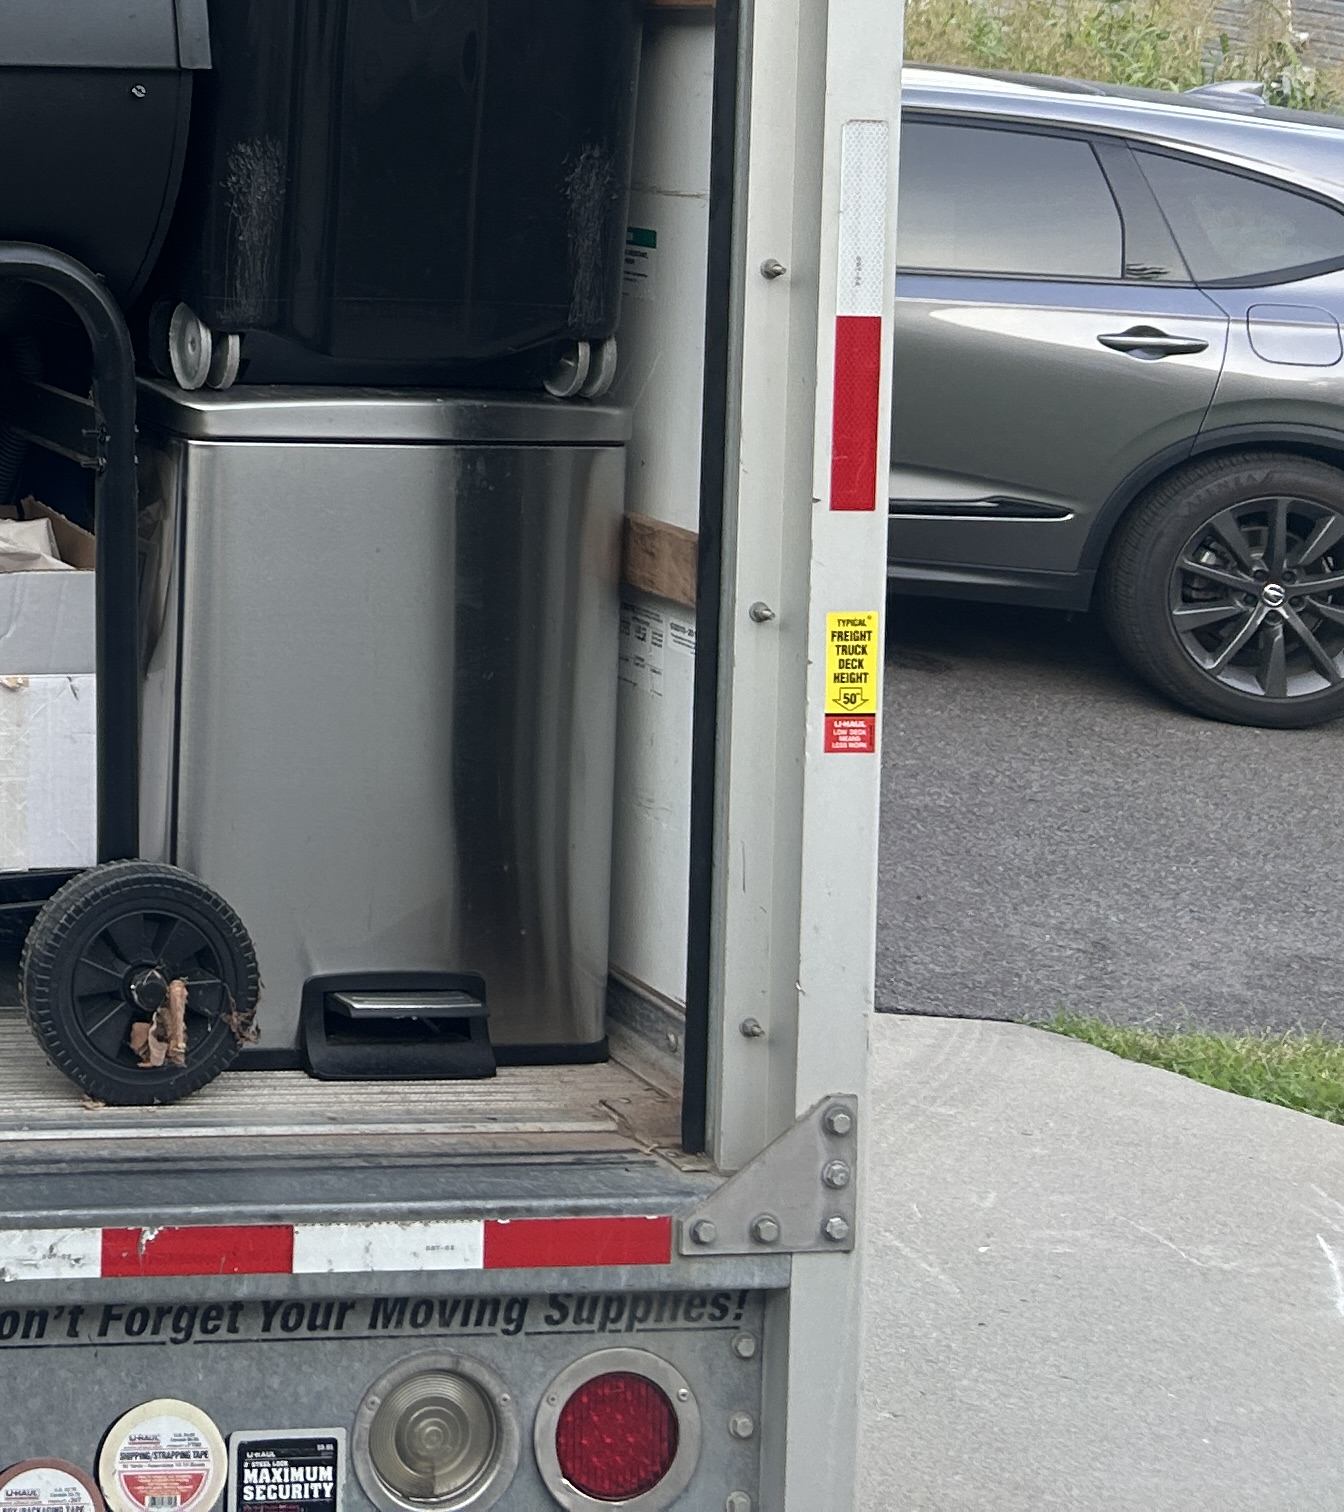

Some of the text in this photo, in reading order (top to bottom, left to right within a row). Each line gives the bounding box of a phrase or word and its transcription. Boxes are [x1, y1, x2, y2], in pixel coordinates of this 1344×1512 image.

[831, 630, 872, 642] FREIGHT
[836, 645, 868, 656] TRUCK
[838, 659, 864, 669] DECK
[834, 673, 869, 683] HEIGHT
[99, 1301, 241, 1345] Forget
[258, 1298, 352, 1333] Your
[368, 1293, 525, 1336] Moving
[243, 1466, 333, 1484] MAXIMUM
[243, 1482, 333, 1501] SECURITY
